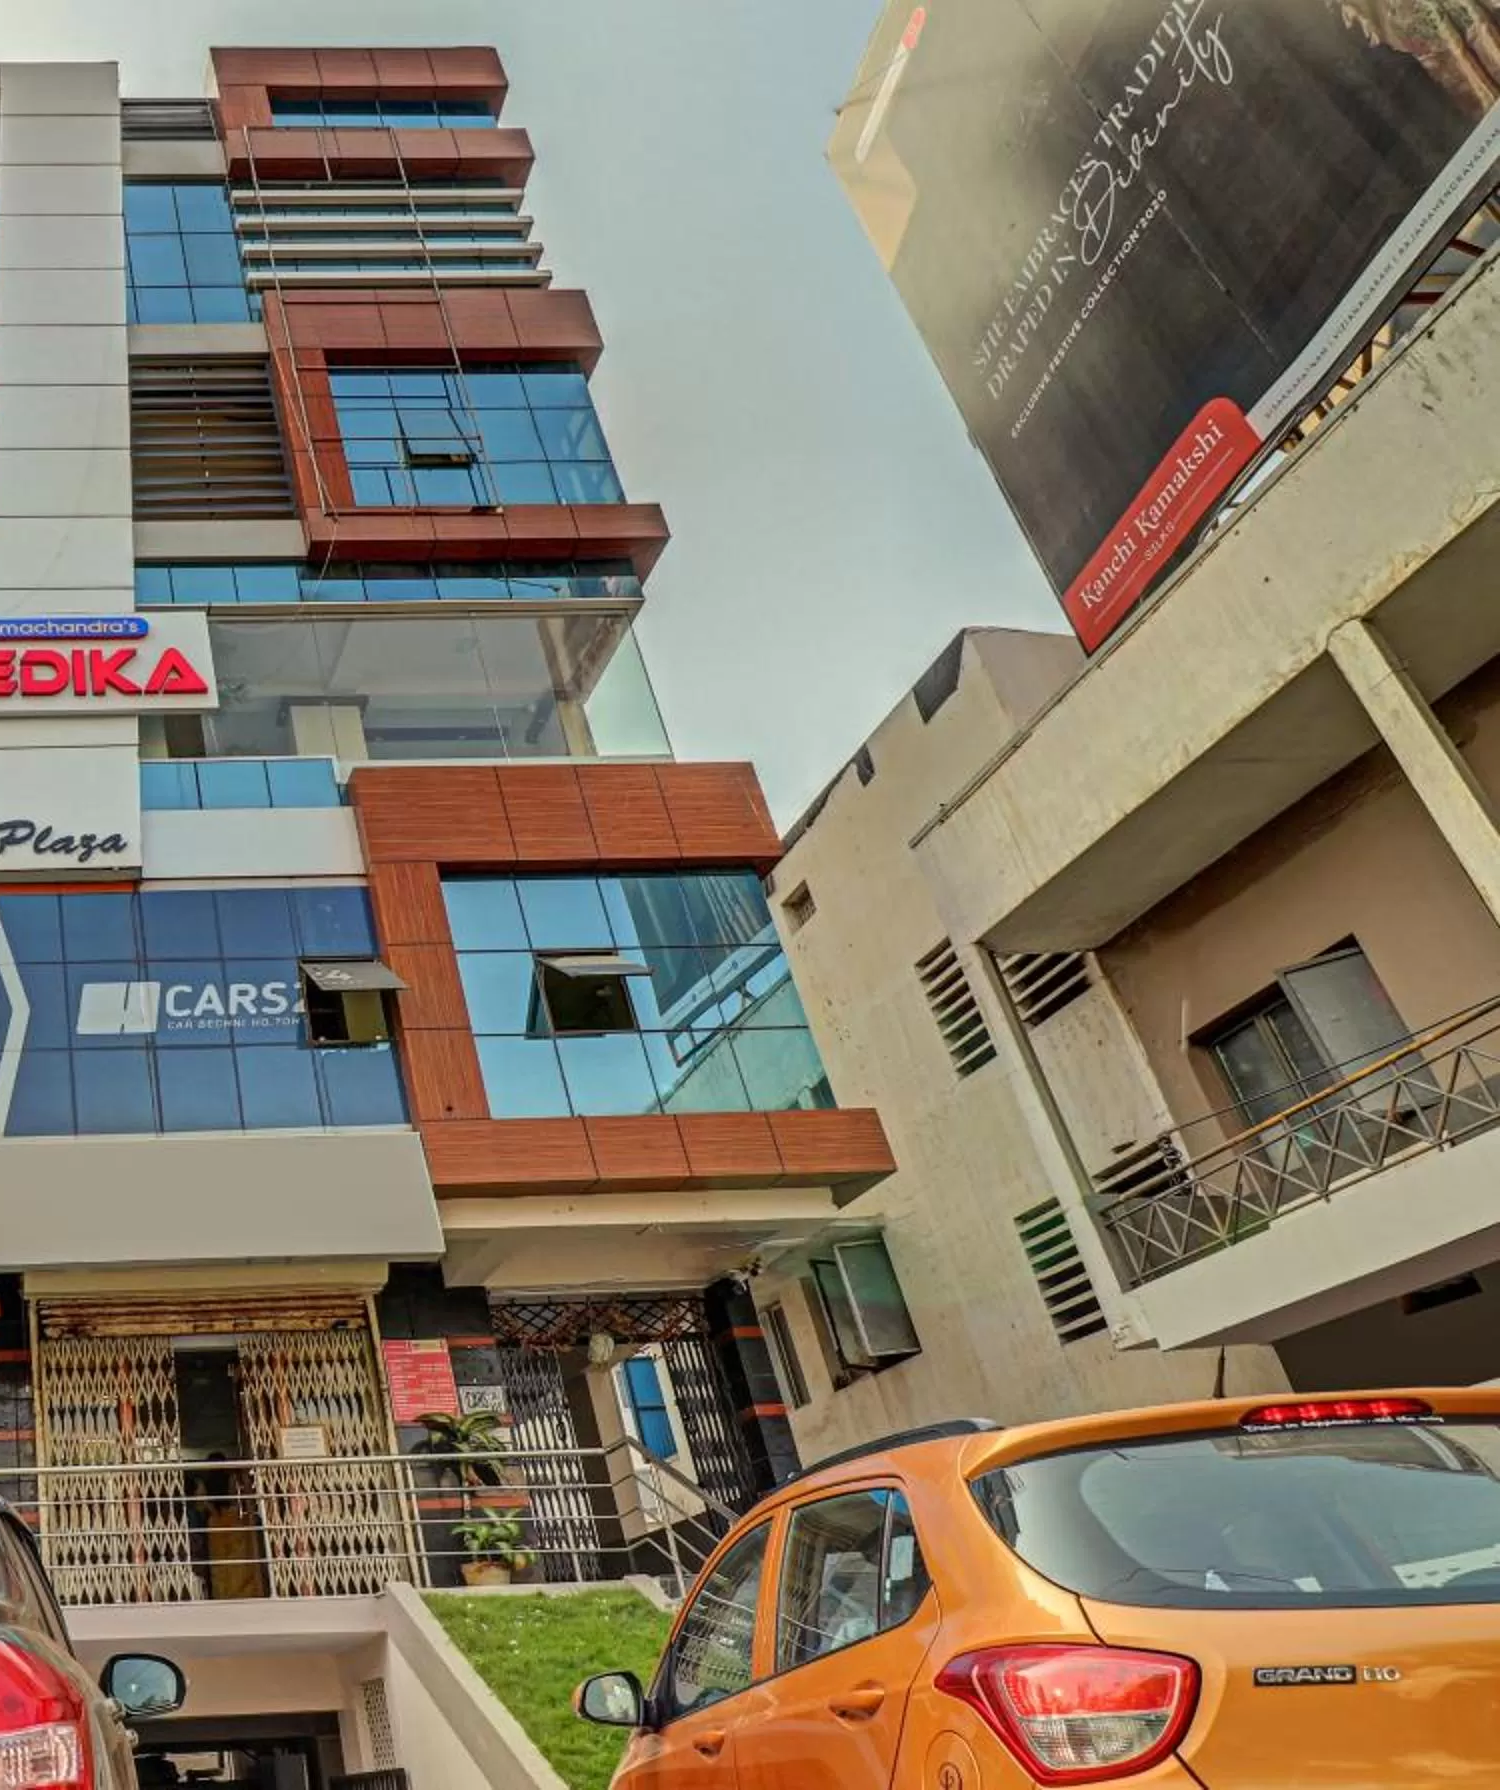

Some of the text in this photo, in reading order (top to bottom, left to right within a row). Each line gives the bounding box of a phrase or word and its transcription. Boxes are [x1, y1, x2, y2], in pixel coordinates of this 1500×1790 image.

[987, 285, 1053, 400] DRAPED
[1073, 2, 1233, 265] Divinity
[1011, 371, 1051, 439] EXCLUSIVE
[1049, 319, 1083, 374] FESTIVE
[1079, 418, 1226, 609] Kanchi Kamakshi
[1257, 1667, 1353, 1684] GRAND
